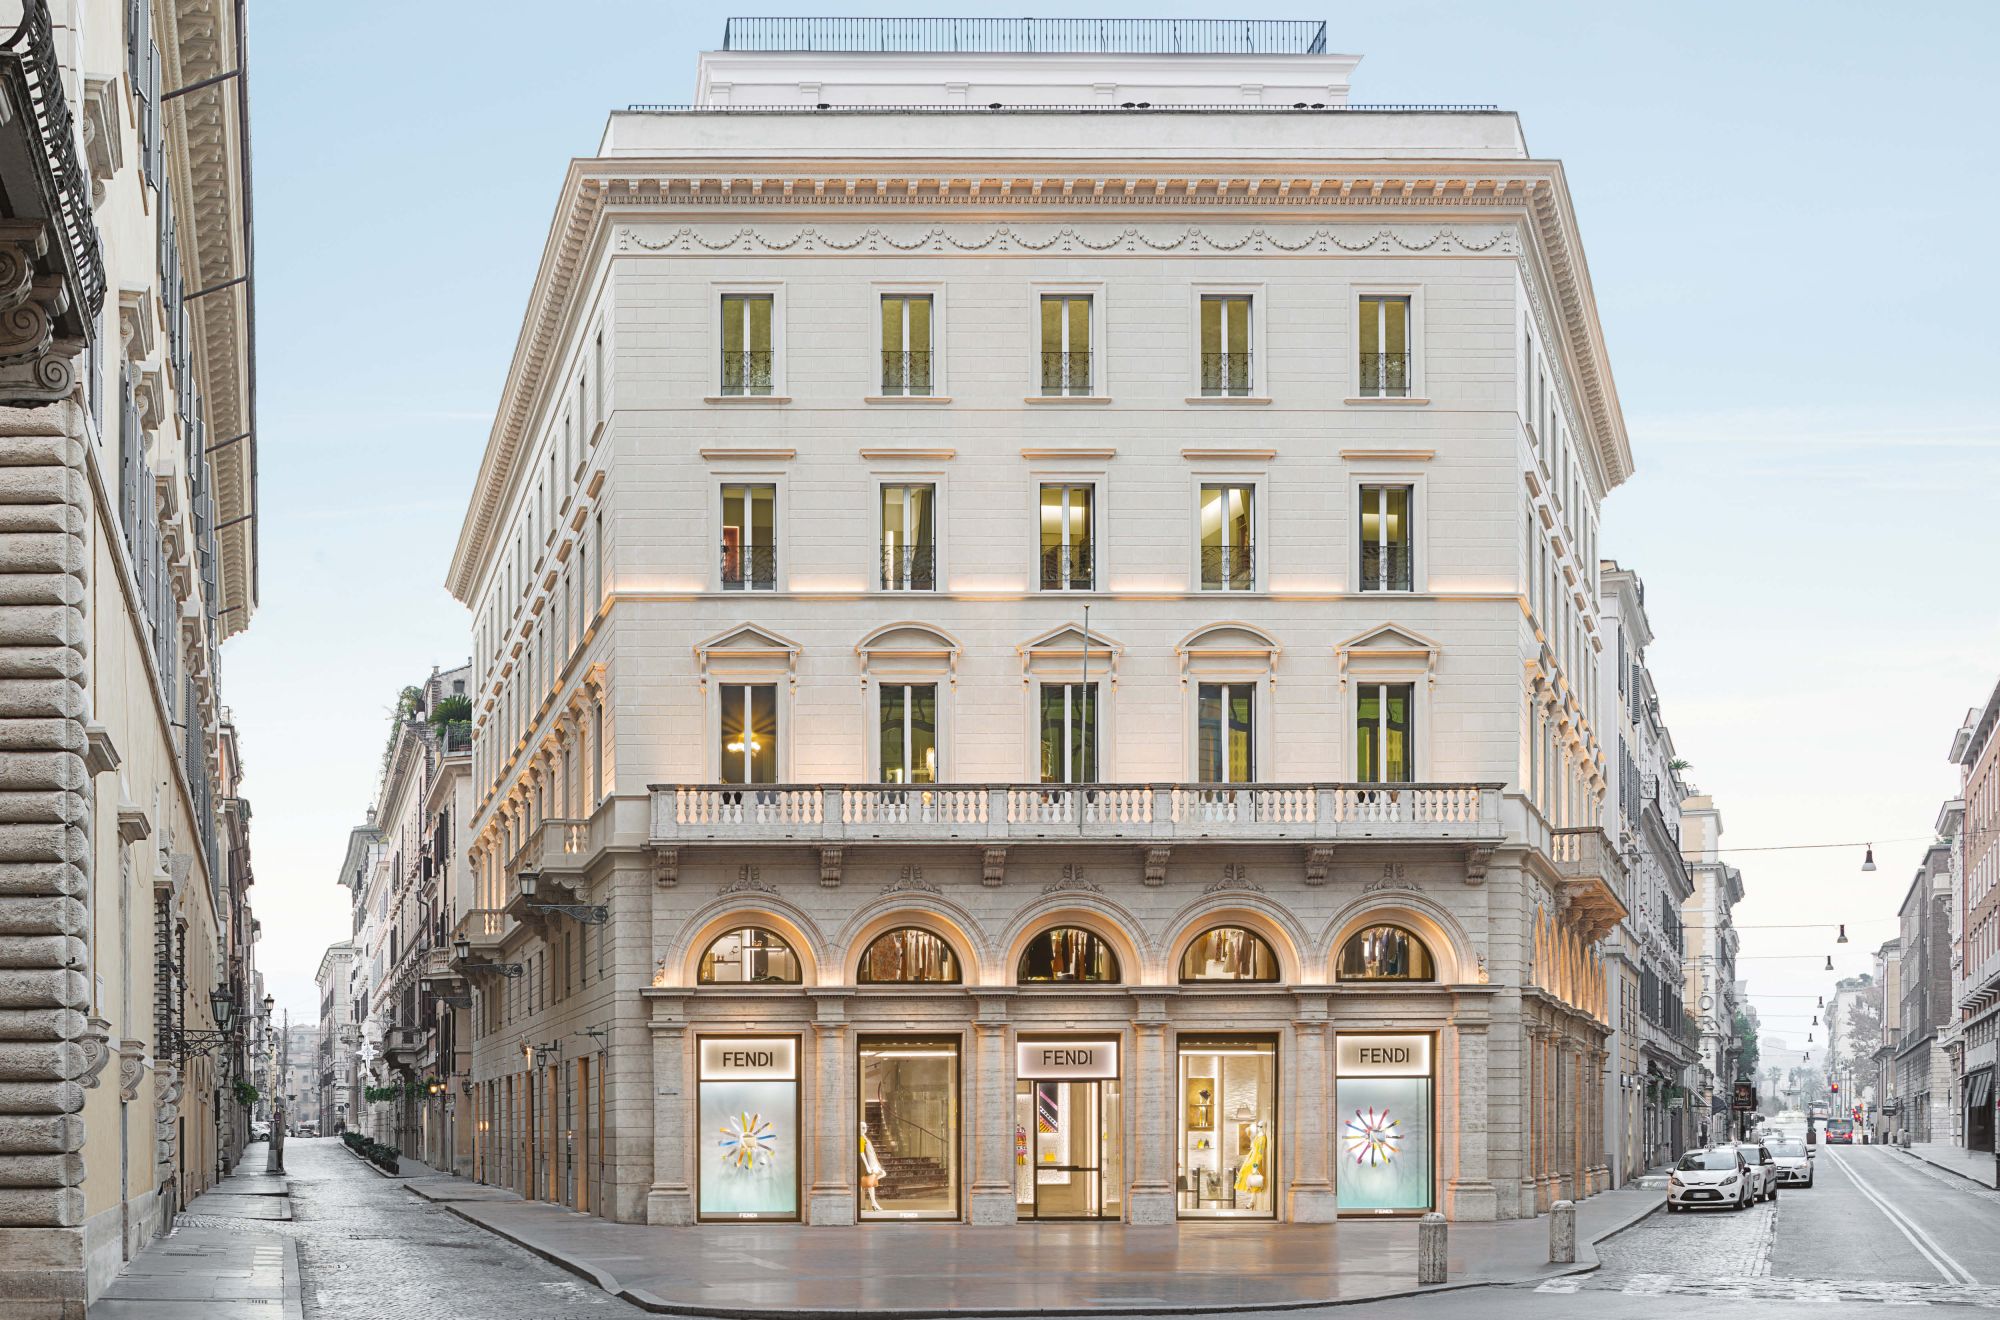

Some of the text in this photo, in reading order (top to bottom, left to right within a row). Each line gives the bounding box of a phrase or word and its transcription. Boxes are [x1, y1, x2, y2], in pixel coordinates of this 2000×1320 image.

[723, 1051, 773, 1067] FENDI
[1043, 1050, 1093, 1065] FENDI
[1360, 1047, 1410, 1063] FENDI
